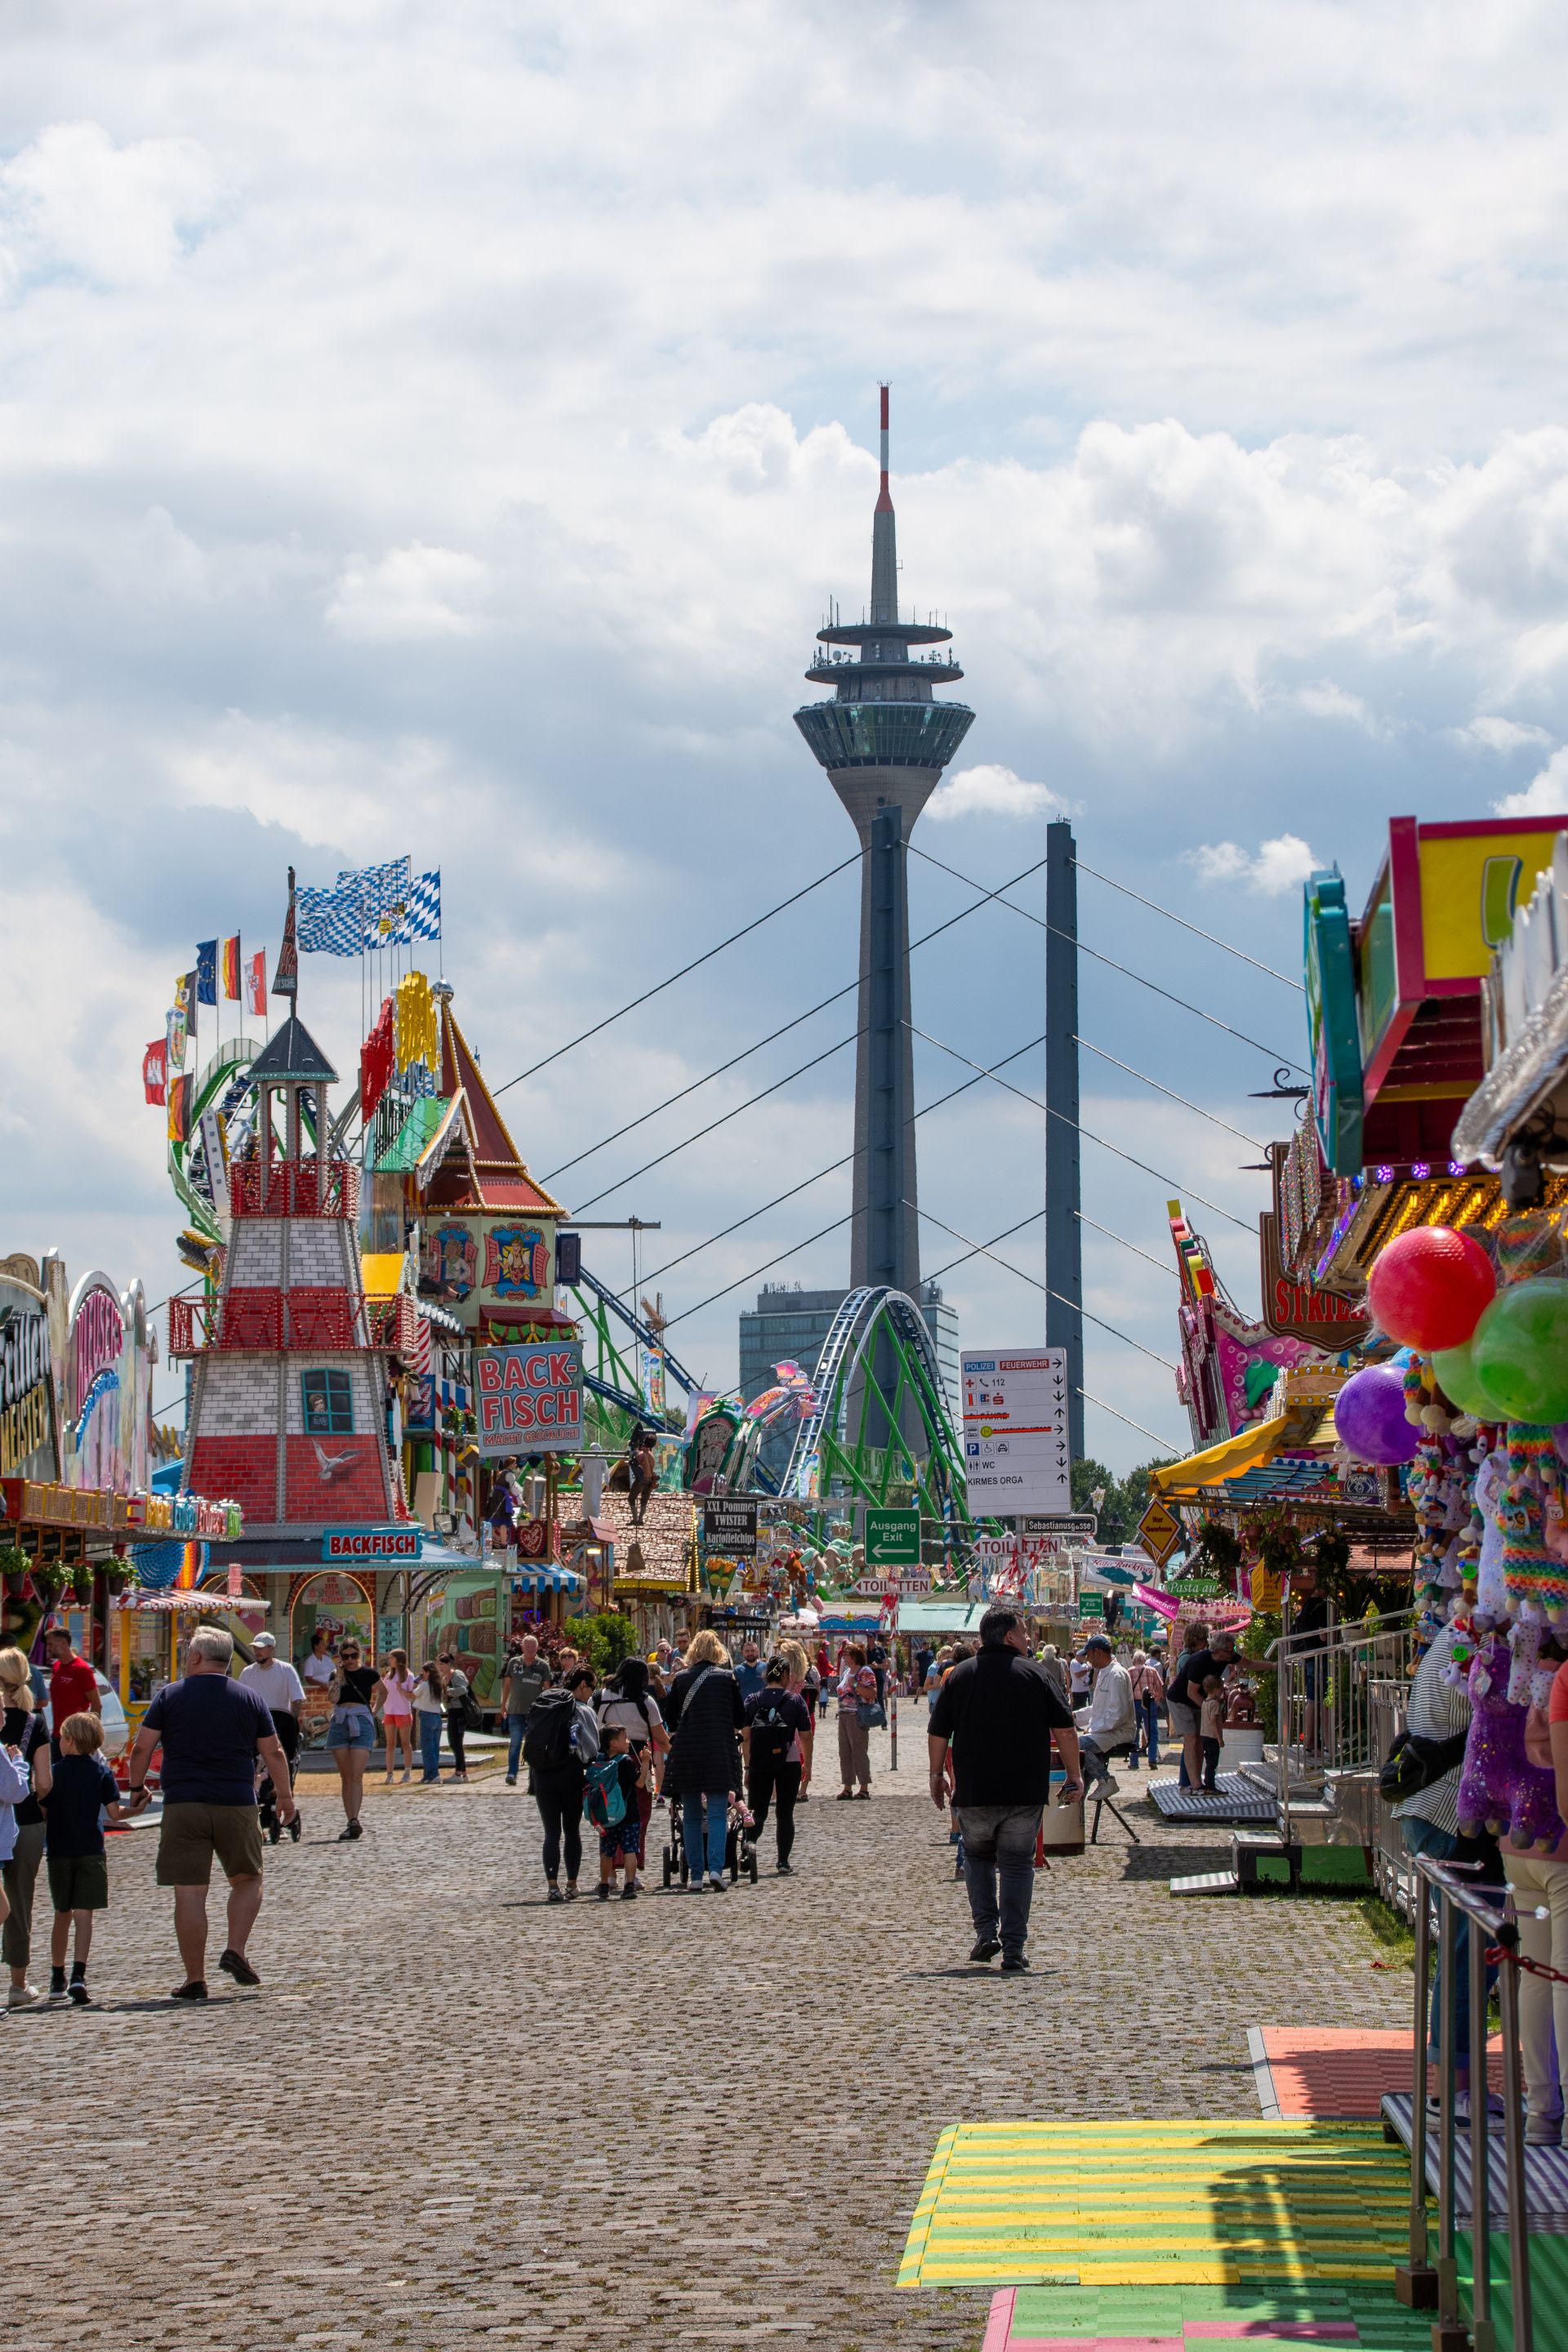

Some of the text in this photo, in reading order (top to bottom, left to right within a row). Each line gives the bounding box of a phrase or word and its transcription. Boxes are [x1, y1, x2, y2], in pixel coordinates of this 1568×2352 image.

[965, 1360, 1048, 1371] POLIZEI FEUERWEHR
[478, 1352, 577, 1392] BACK-
[482, 1390, 579, 1430] FISCH
[483, 1428, 579, 1446] MACHT GLÜCKLICH!
[968, 1476, 1023, 1486] KIRMES ORGA
[706, 1501, 755, 1512] XXL Pommes
[715, 1514, 748, 1526] TWISTER
[870, 1521, 916, 1532] Ausgang
[1028, 1521, 1092, 1532] Sebastianusgasse
[706, 1532, 755, 1545] Kartoffelchips
[882, 1532, 903, 1542] Exit
[330, 1535, 416, 1555] BACKFISCH
[982, 1539, 1058, 1554] TOILTTEN
[863, 1580, 929, 1592] TOILTTEN
[1169, 1582, 1199, 1593] Pasta
